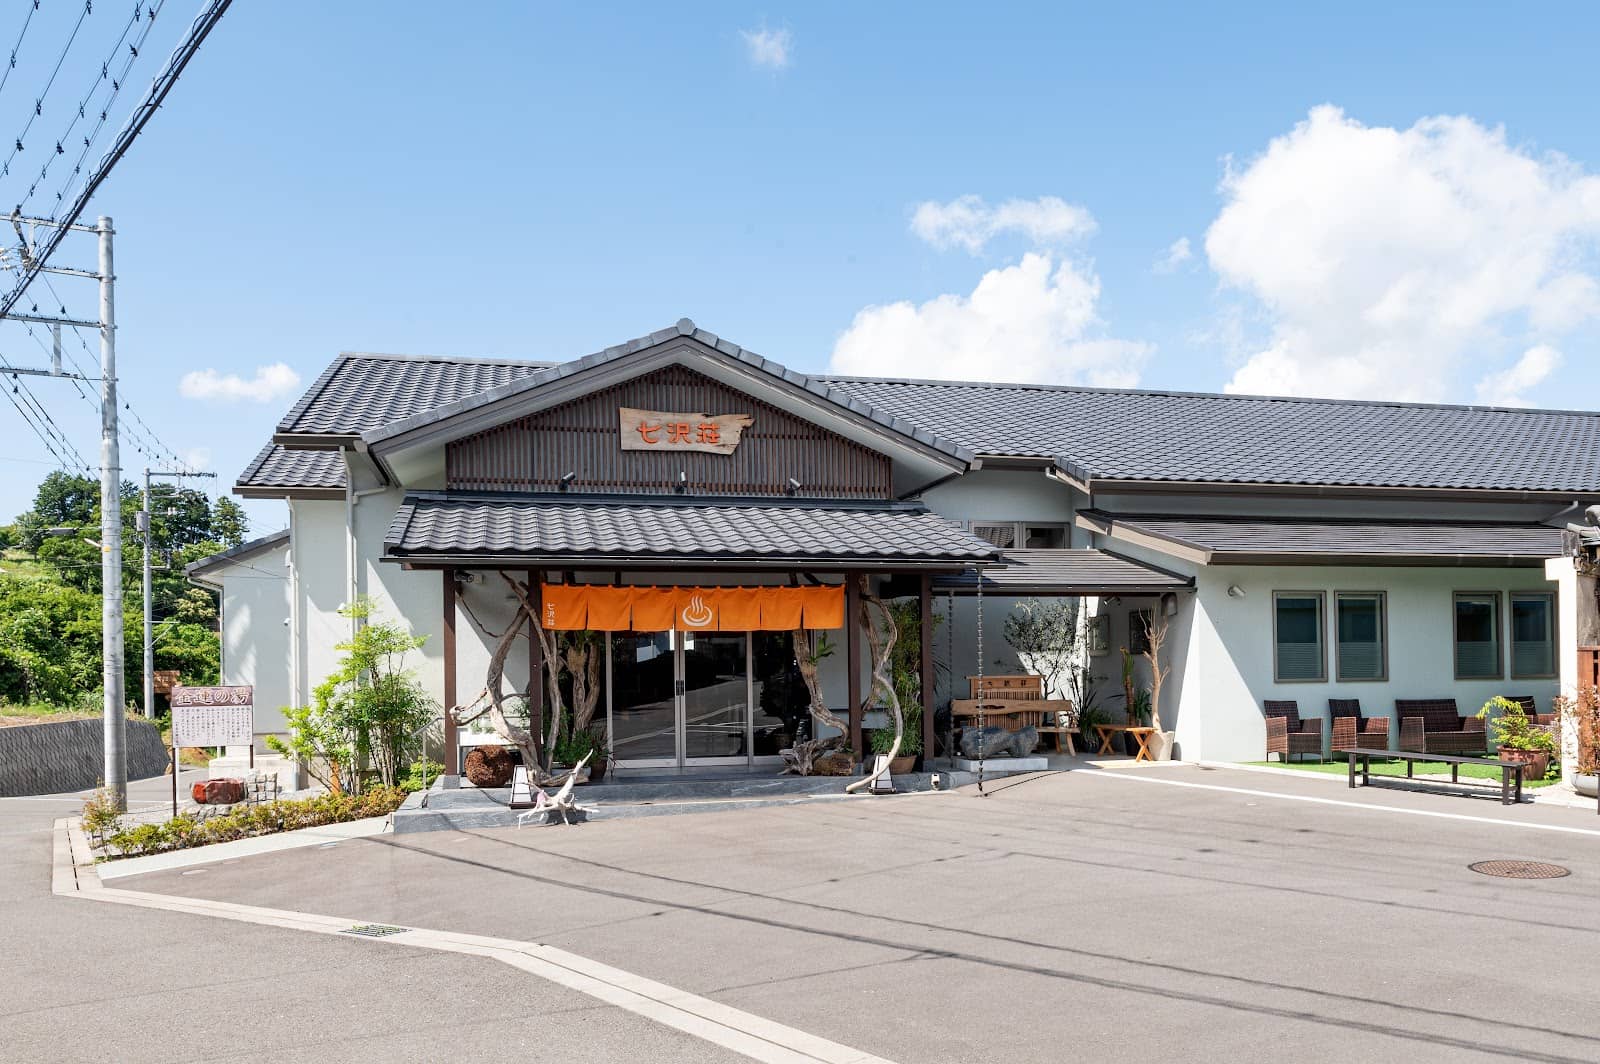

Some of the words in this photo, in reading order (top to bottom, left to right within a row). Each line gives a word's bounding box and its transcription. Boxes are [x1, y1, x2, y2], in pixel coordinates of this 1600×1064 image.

[636, 421, 721, 444] 七沢荘
[176, 687, 249, 705] 金運の湯
